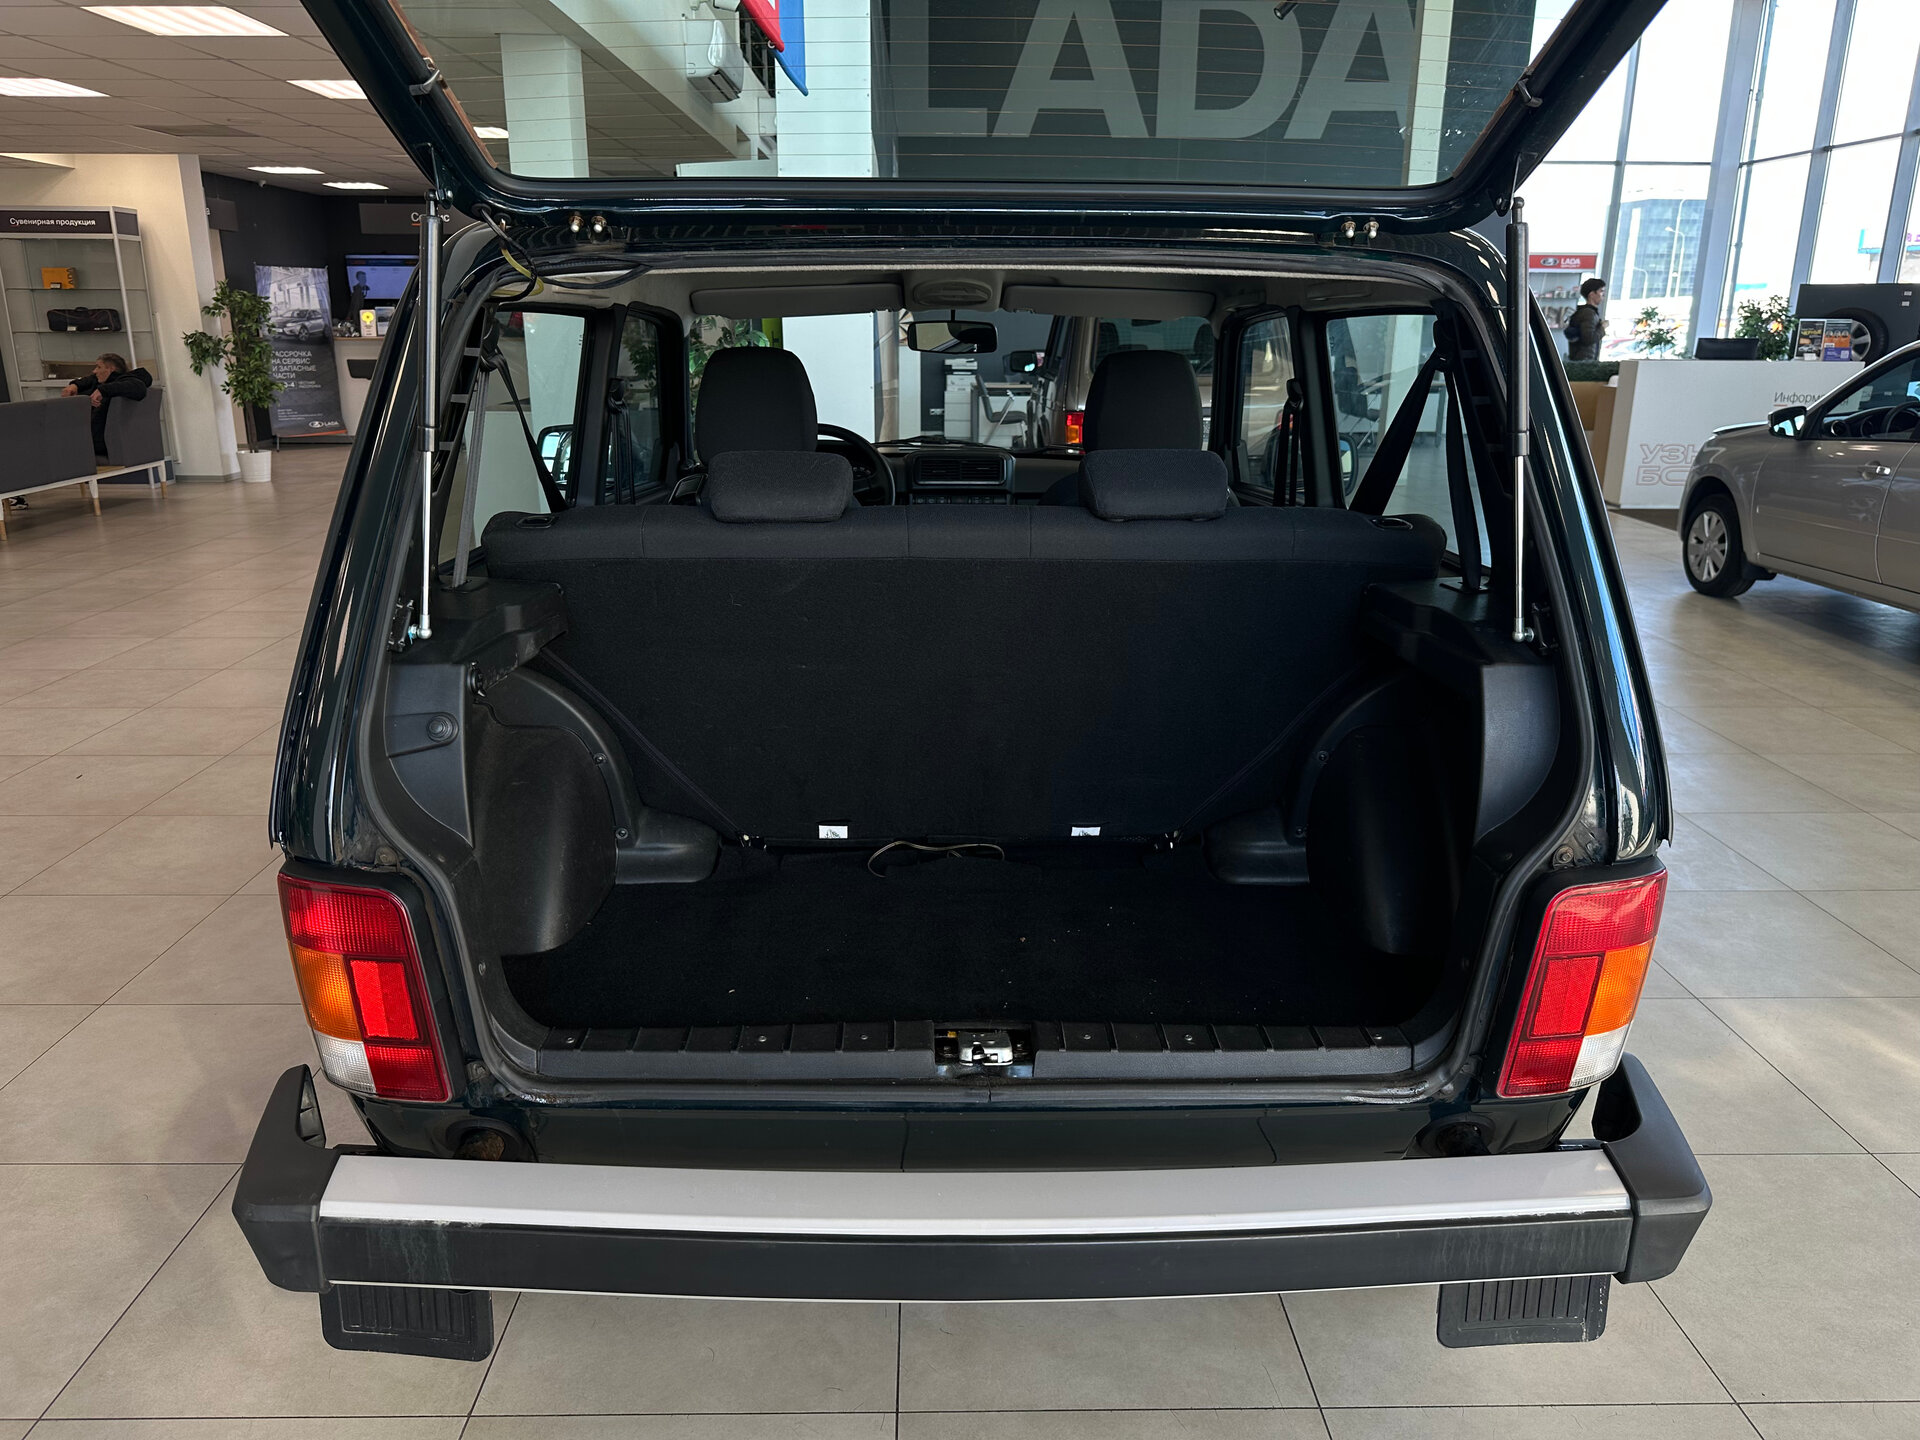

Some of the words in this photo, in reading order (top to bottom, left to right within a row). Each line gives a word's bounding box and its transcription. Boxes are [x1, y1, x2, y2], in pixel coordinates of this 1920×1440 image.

[892, 0, 1418, 139] LADA
[9, 217, 55, 226] Сувенирная
[55, 219, 96, 227] продукция
